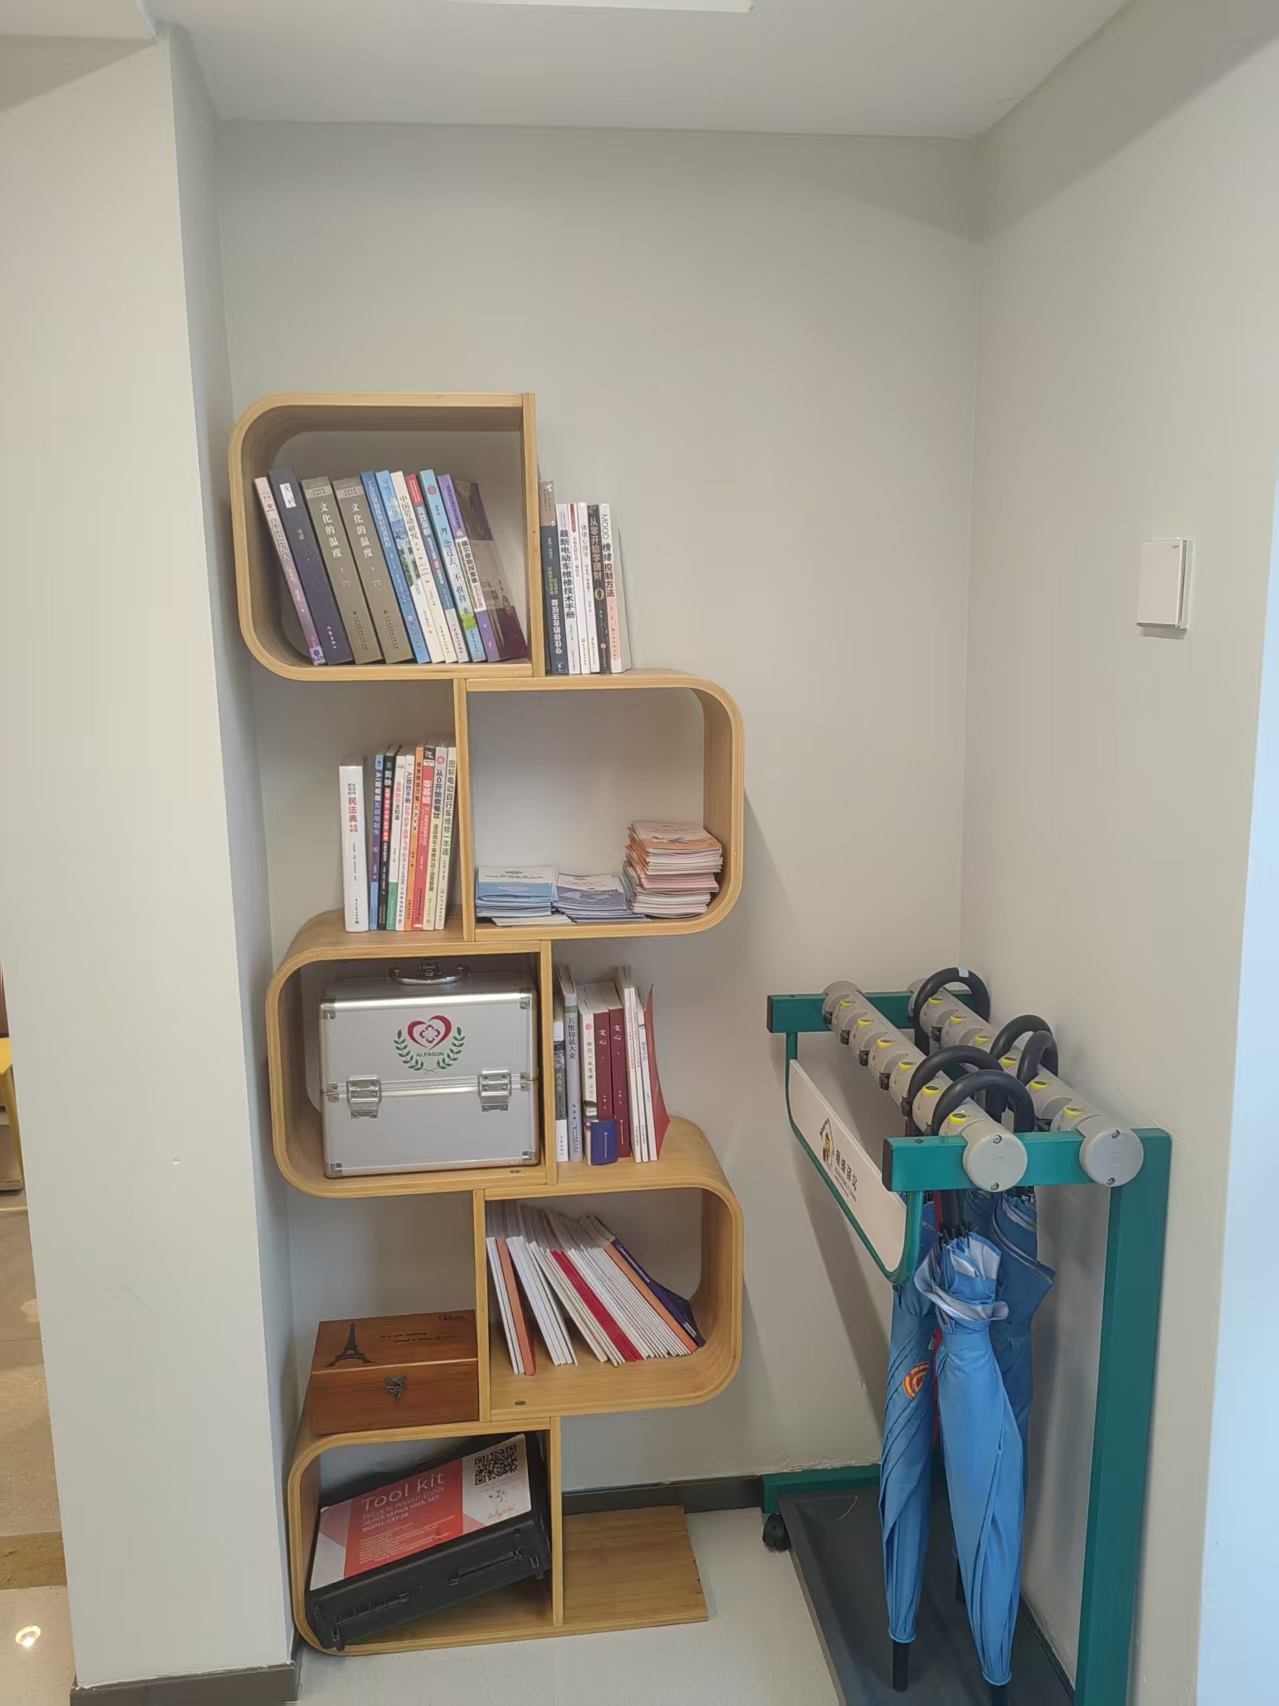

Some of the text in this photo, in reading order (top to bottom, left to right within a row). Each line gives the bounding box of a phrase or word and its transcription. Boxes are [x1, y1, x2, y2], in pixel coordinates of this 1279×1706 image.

[320, 502, 343, 558] 文化的温度
[352, 502, 374, 558] 文化的温度
[560, 529, 575, 619] 最新电动车维修技术手册
[602, 543, 615, 597] 情绪控制方法
[348, 796, 358, 823] 民法典
[363, 1473, 445, 1512] Tool kit
